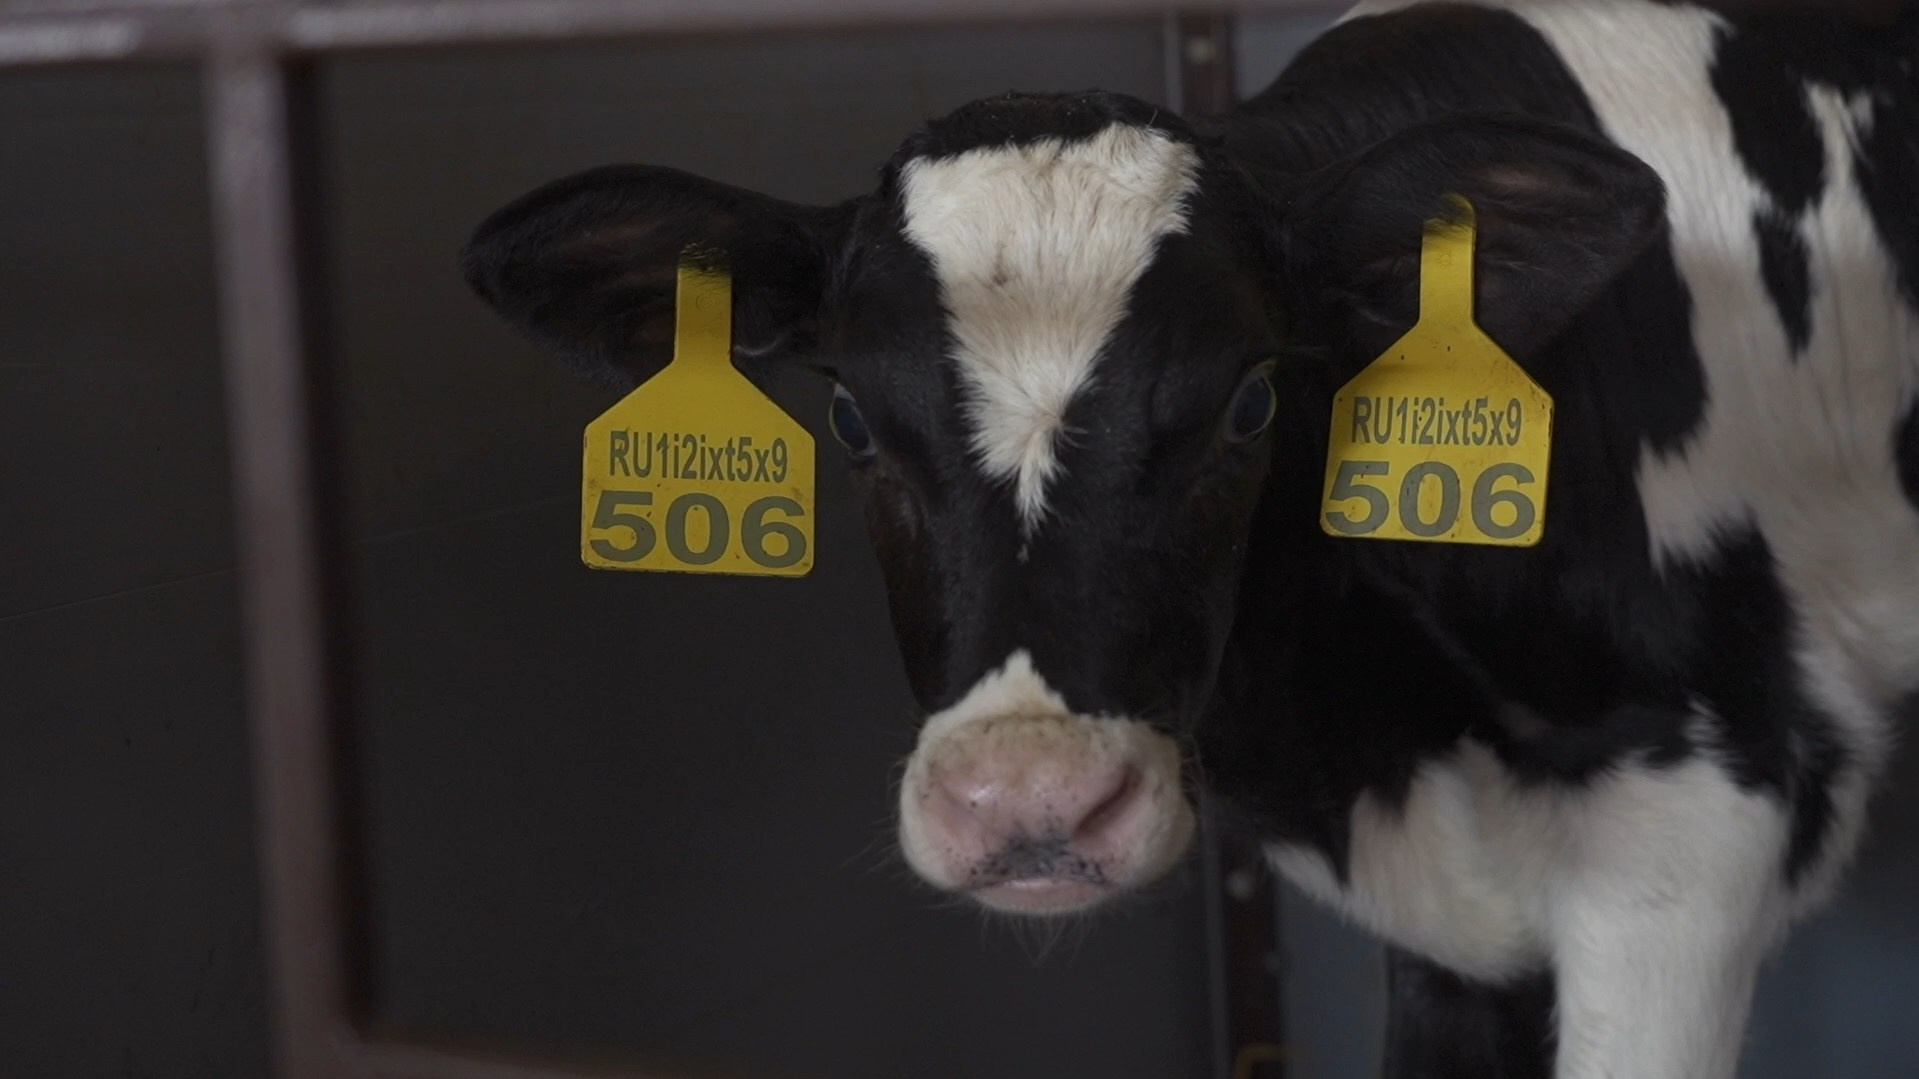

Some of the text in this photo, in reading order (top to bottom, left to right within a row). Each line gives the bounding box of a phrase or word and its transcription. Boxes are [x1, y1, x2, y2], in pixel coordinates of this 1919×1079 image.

[1351, 396, 1522, 447] RU1i2ixt5x9
[609, 430, 788, 484] RU1i2ixt5x9
[590, 489, 808, 569] 506
[1325, 460, 1536, 539] 506
